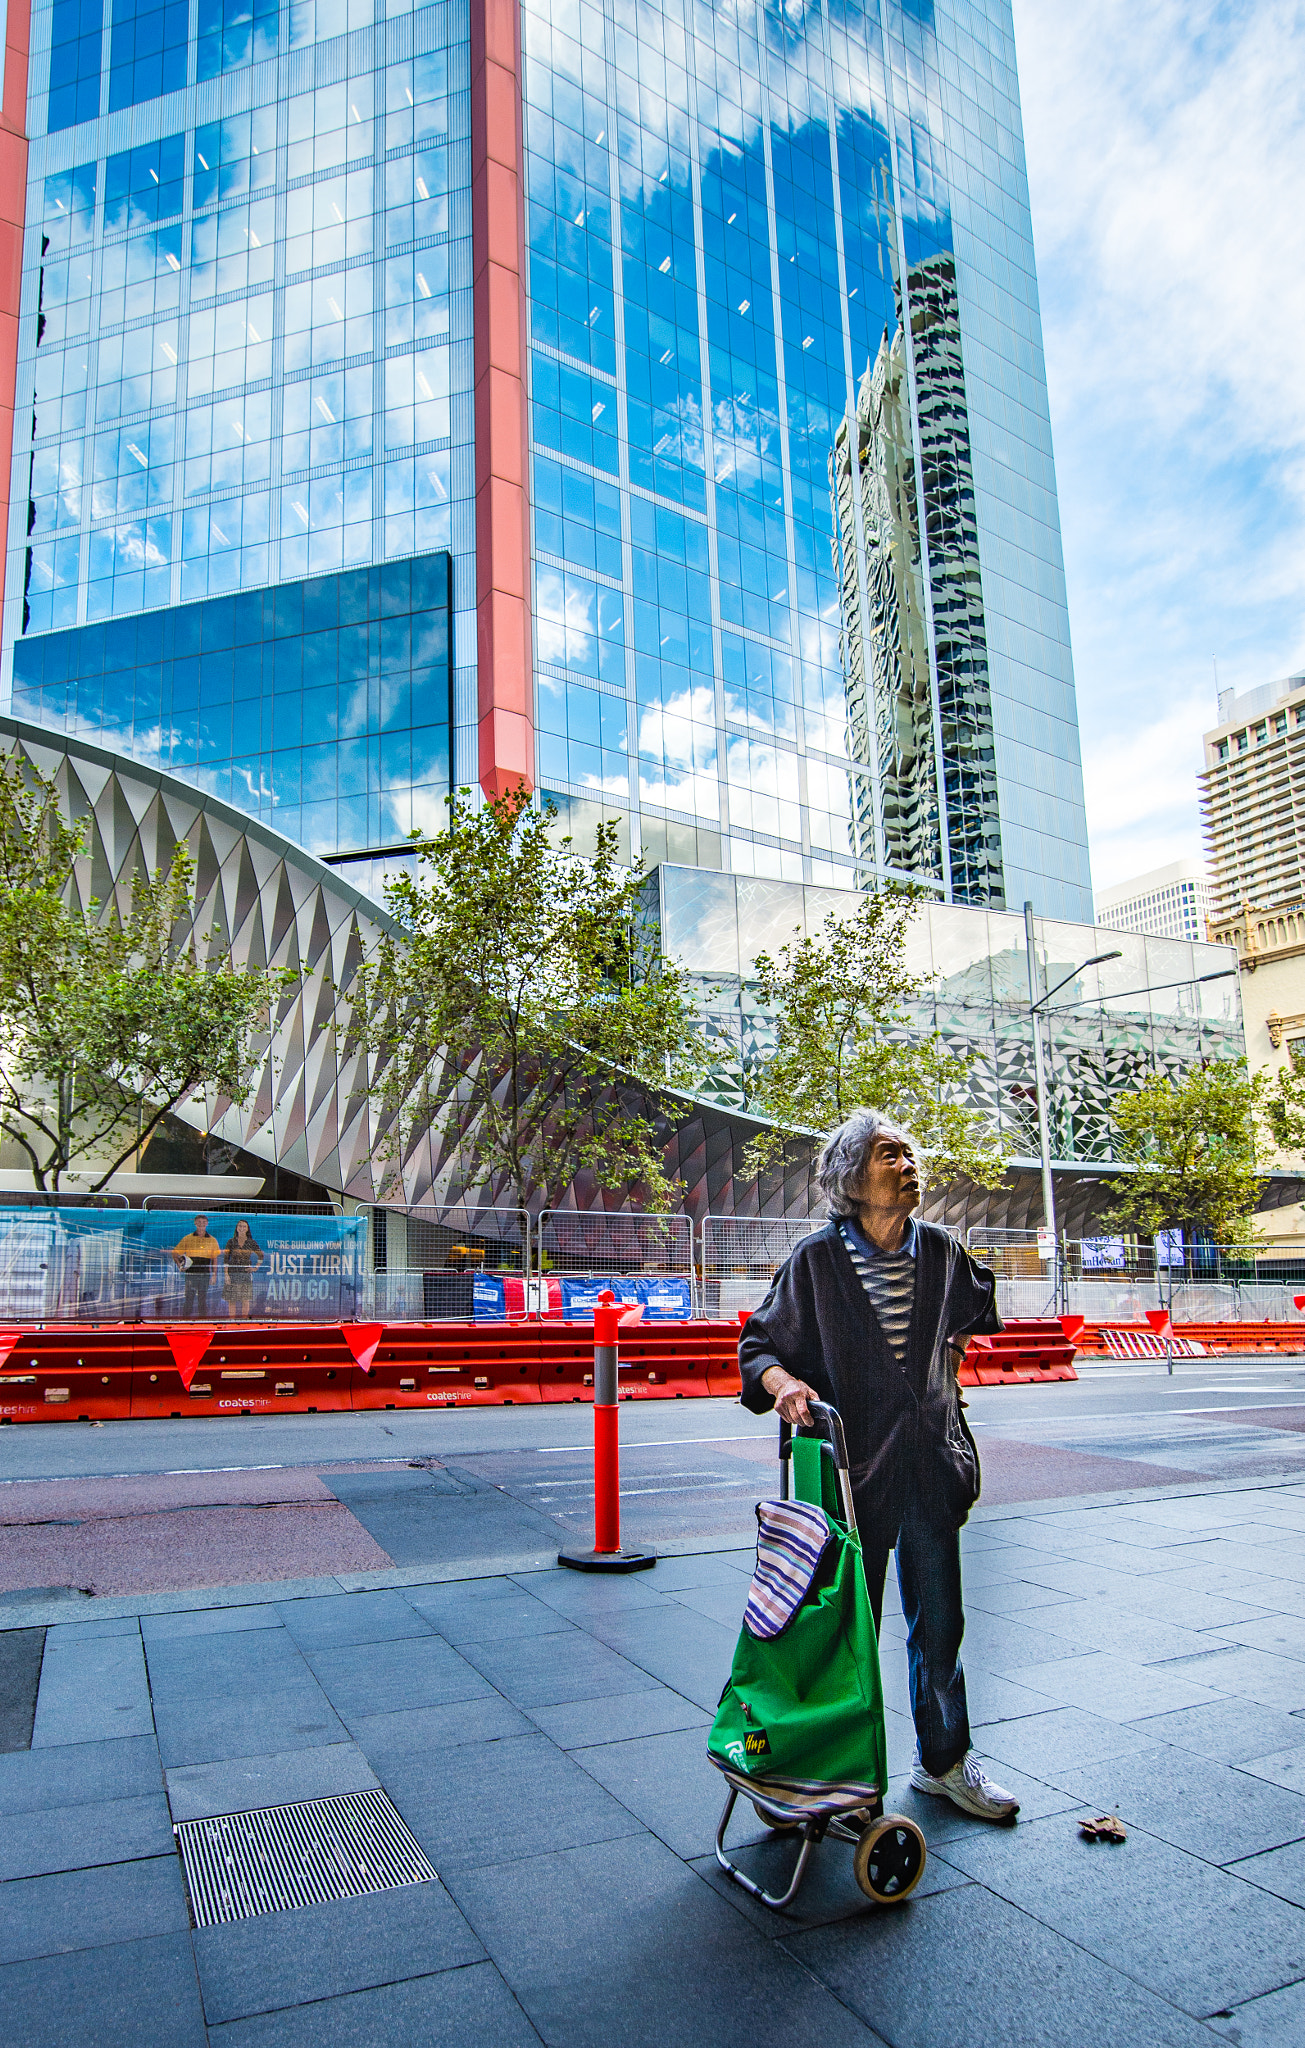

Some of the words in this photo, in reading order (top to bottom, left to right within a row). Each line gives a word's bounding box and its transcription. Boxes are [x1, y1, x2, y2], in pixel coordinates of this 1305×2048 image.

[266, 1239, 289, 1250] WE'RE
[291, 1240, 323, 1250] BUILDING
[325, 1240, 342, 1250] YOUR
[343, 1240, 362, 1250] LIGHT
[266, 1254, 306, 1275] JUST
[310, 1254, 352, 1275] TURN
[266, 1279, 302, 1301] AND
[307, 1279, 334, 1301] GO.
